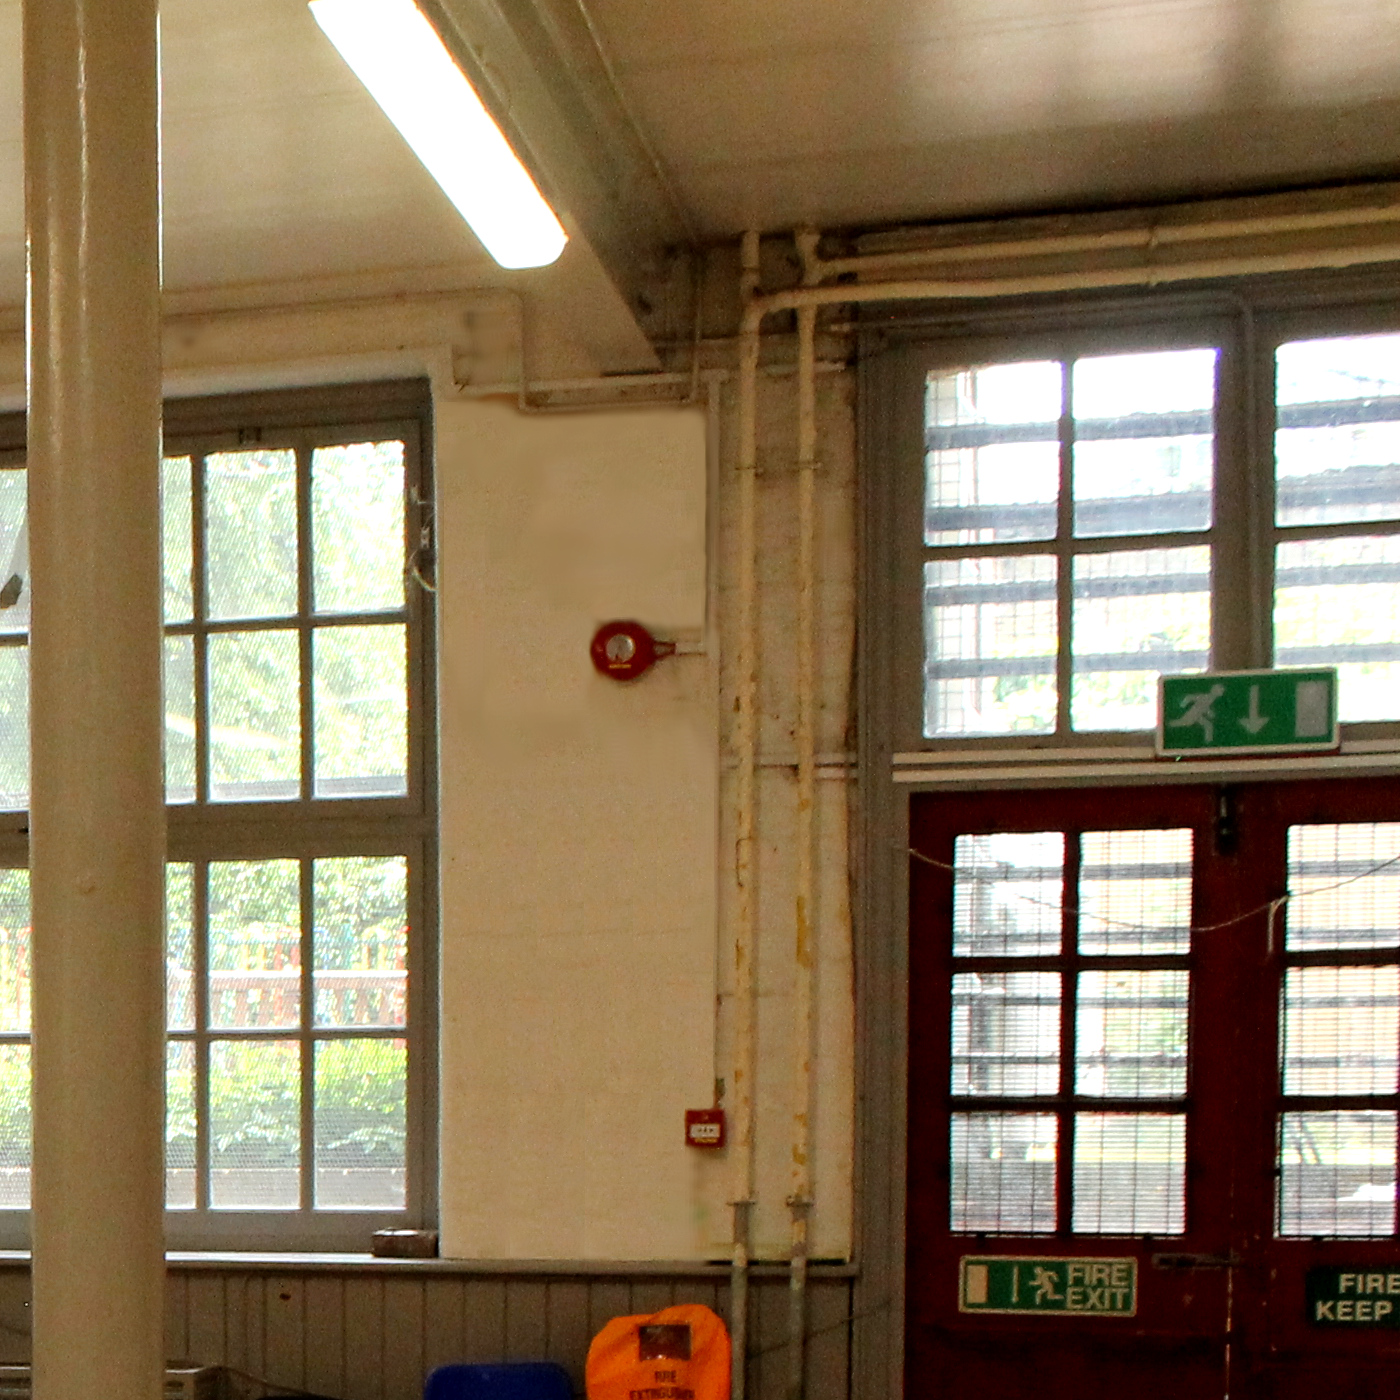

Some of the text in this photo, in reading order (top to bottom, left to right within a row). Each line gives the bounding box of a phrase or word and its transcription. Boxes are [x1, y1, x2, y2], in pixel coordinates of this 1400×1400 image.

[1068, 1264, 1129, 1286] FIRE
[1340, 1274, 1400, 1294] FIRE
[1066, 1287, 1129, 1309] EXIT
[1316, 1301, 1393, 1321] KEEP
[654, 1370, 677, 1383] FIRE
